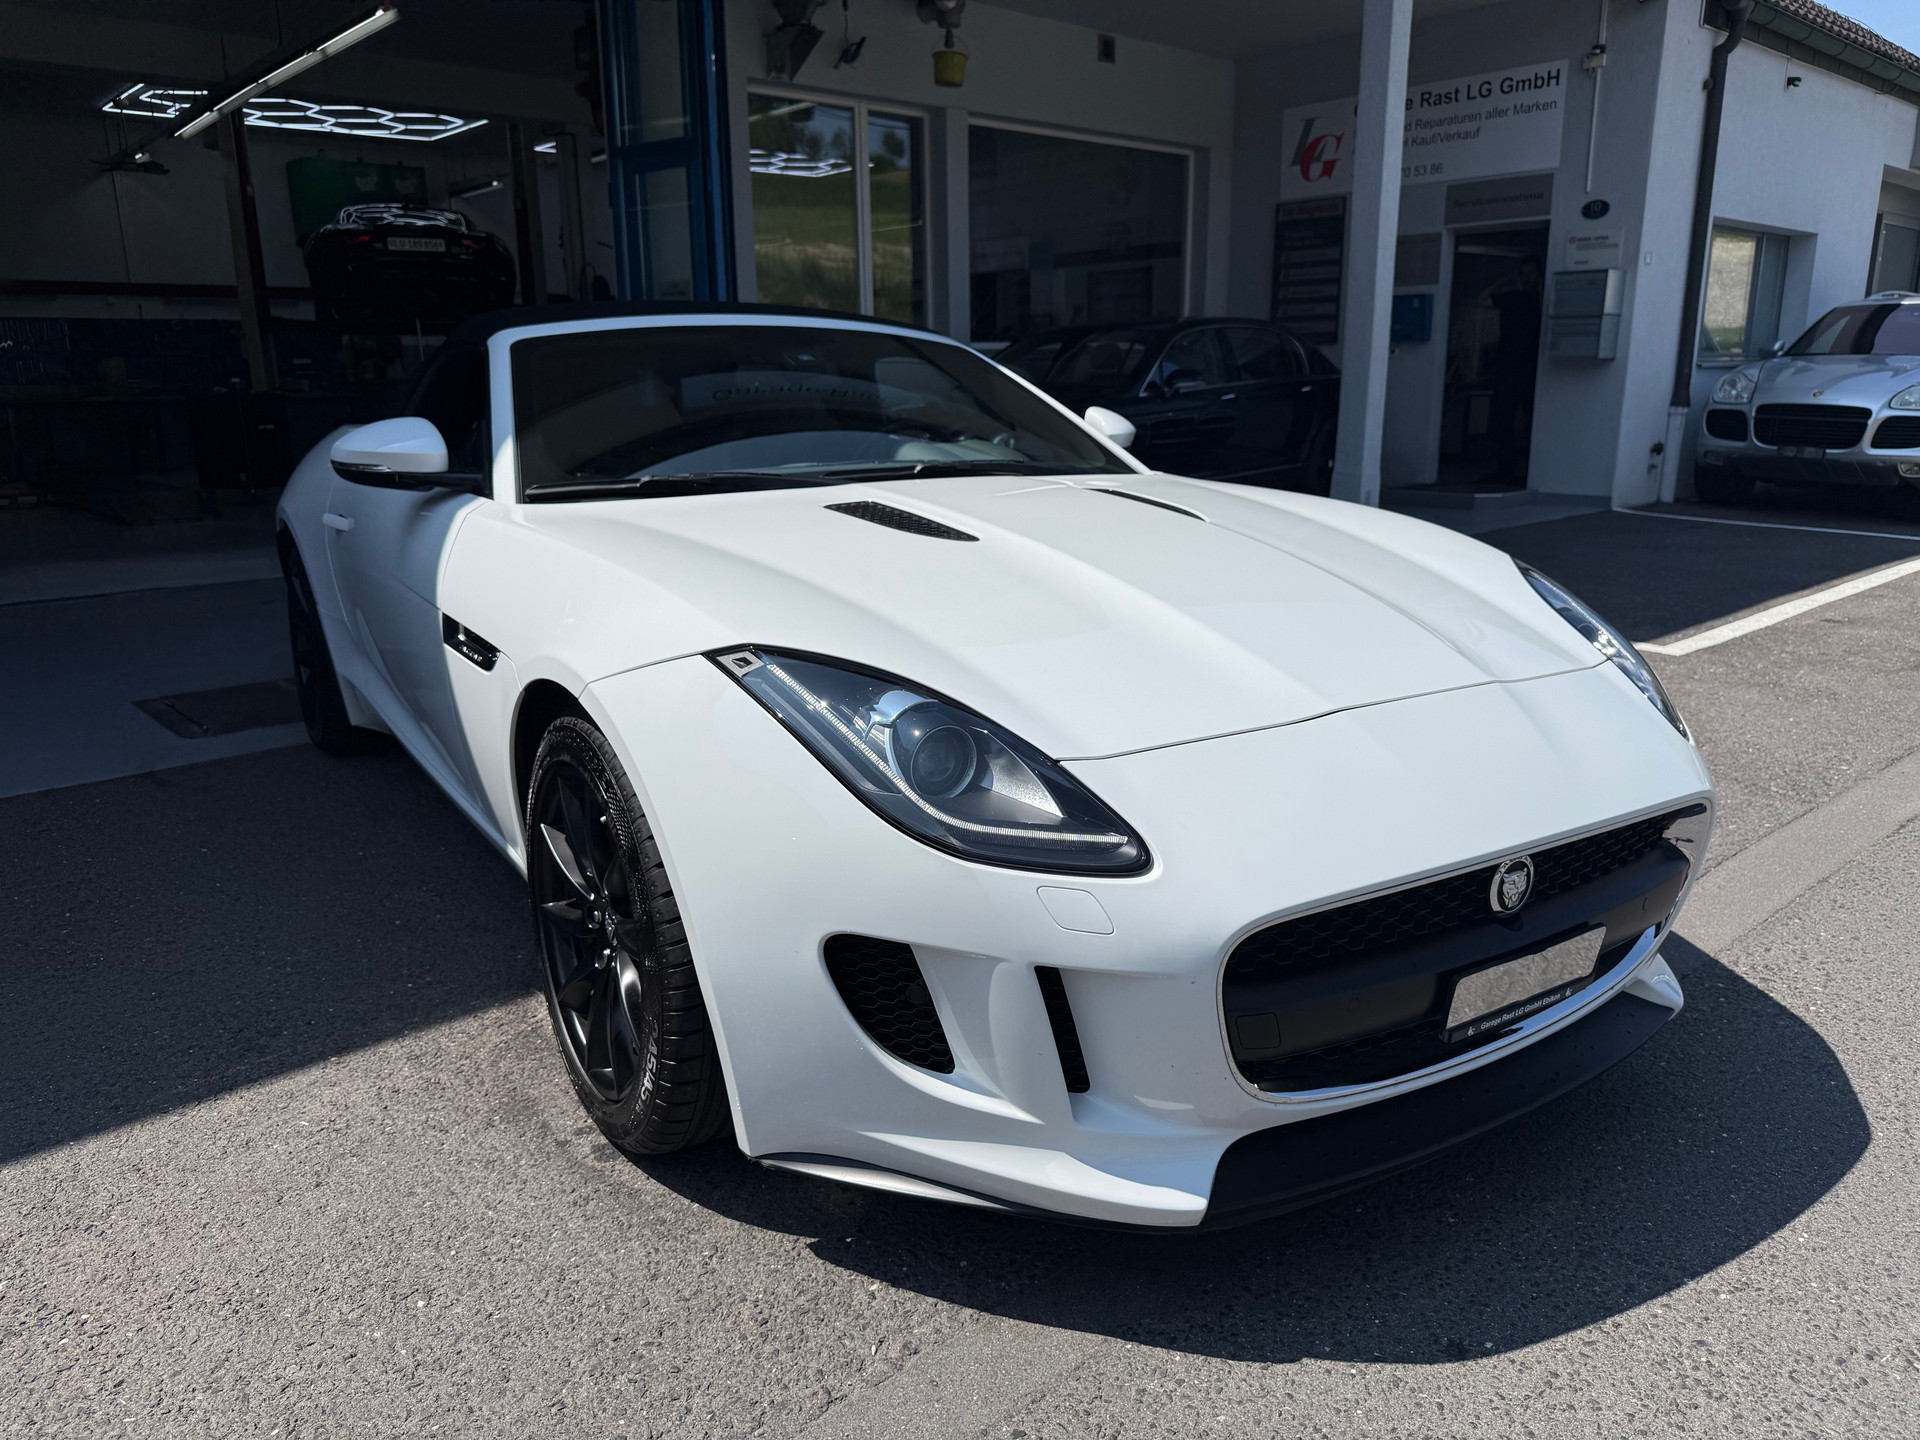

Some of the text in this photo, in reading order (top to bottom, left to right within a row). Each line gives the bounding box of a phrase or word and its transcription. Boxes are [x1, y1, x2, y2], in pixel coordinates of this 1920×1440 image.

[1419, 86, 1460, 109] Rast
[1465, 80, 1493, 102] LG
[1499, 68, 1561, 95] GmbH
[1414, 111, 1482, 131] Reparaturen
[1484, 106, 1511, 119] aller
[1512, 98, 1558, 116] Marken
[1410, 127, 1481, 148] Kauf/Verkauf
[1413, 164, 1427, 177] 53
[1429, 162, 1444, 175] 86
[1480, 1016, 1502, 1029] Garage
[1502, 1011, 1515, 1022] Rast
[1515, 1006, 1524, 1016] LG
[1524, 1000, 1542, 1013] GmbH
[1542, 992, 1561, 1006] Ebikon
